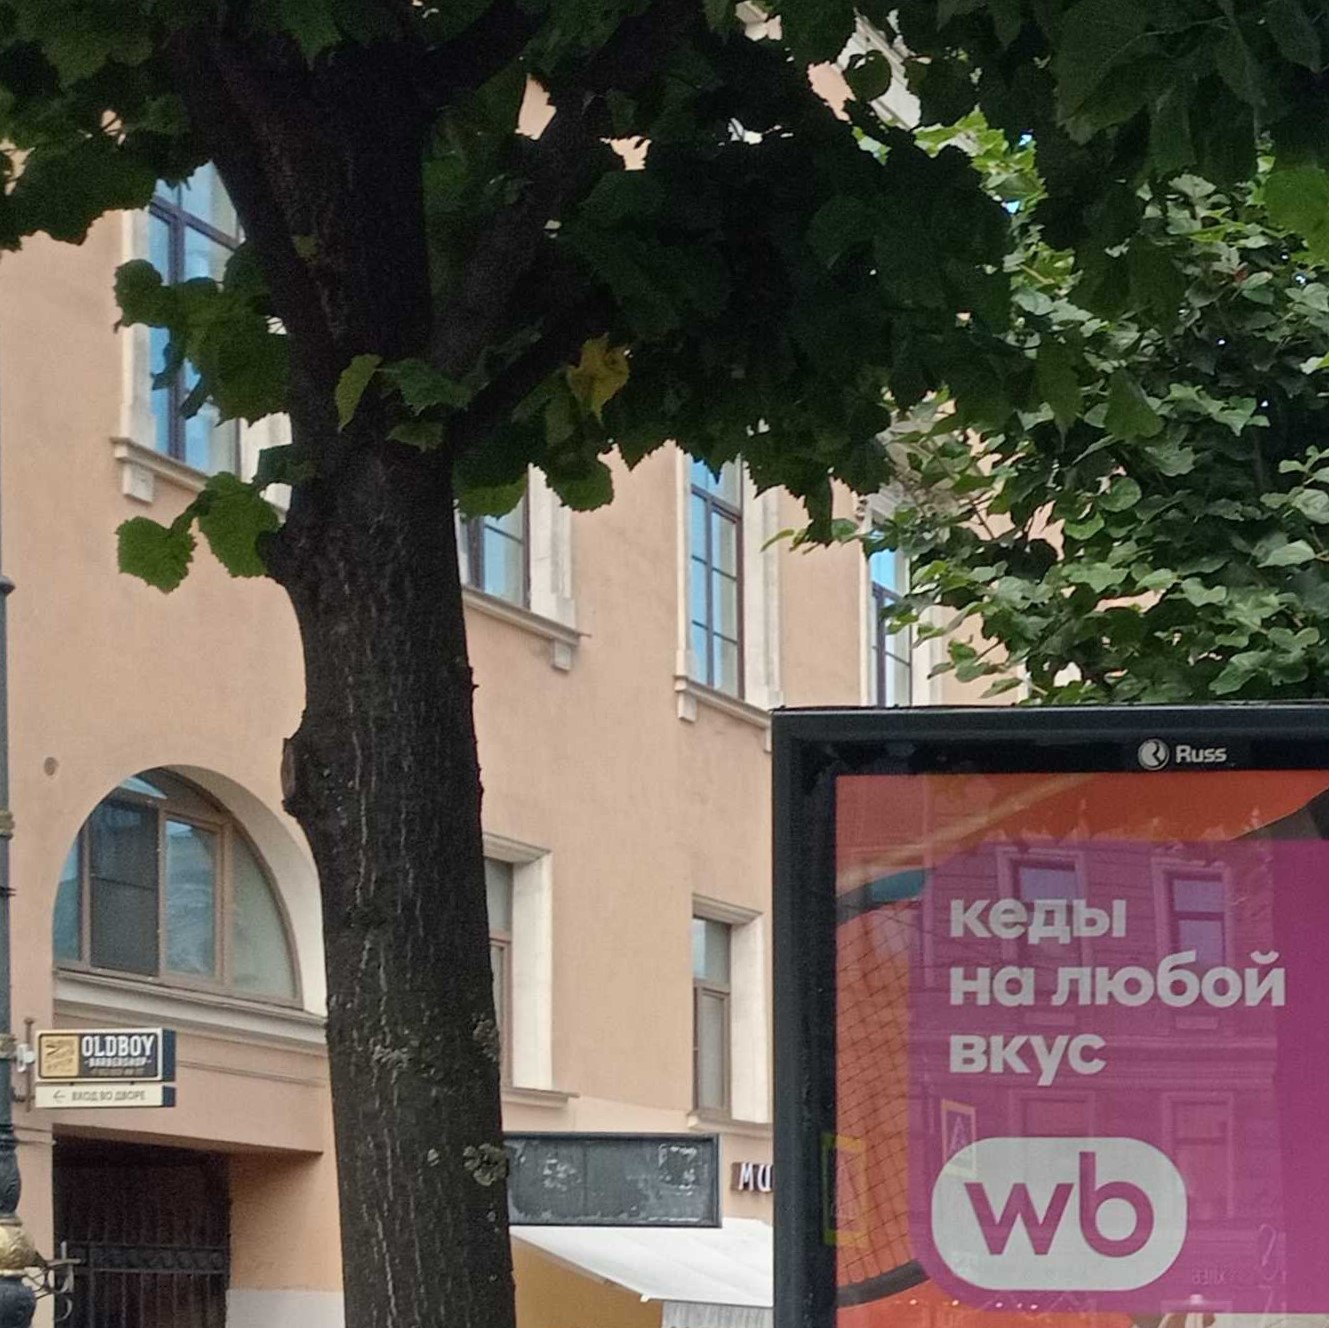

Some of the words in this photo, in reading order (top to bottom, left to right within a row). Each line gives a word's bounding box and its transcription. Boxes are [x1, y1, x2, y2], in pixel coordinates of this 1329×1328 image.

[1175, 744, 1227, 763] Russ
[949, 898, 1127, 944] кеды
[949, 965, 1035, 1006] на
[1051, 949, 1286, 1007] любой
[82, 1035, 154, 1057] OLDBOY
[949, 1033, 1107, 1086] вкус
[964, 1151, 1155, 1258] wb
